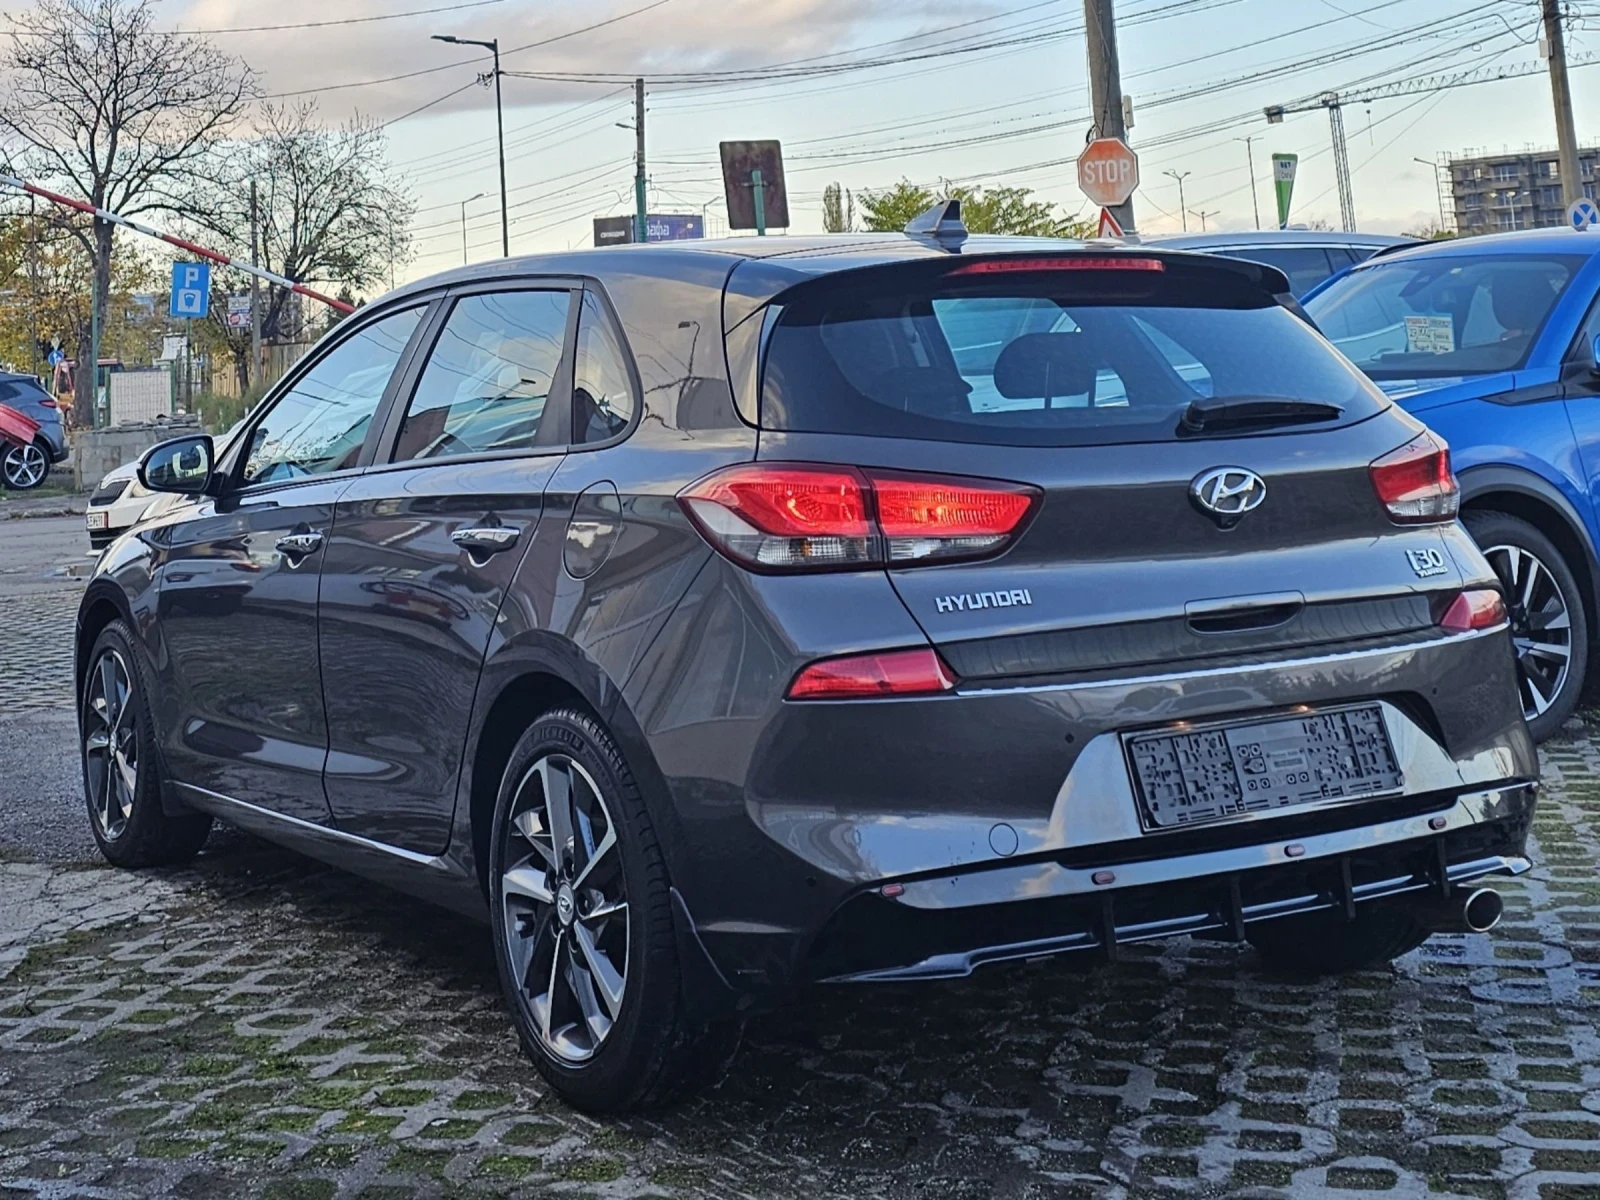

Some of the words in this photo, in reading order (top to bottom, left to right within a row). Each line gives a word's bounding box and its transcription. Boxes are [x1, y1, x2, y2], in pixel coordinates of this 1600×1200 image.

[1084, 159, 1131, 184] STOP
[185, 267, 199, 288] P
[935, 589, 1033, 613] HYUNDAI
